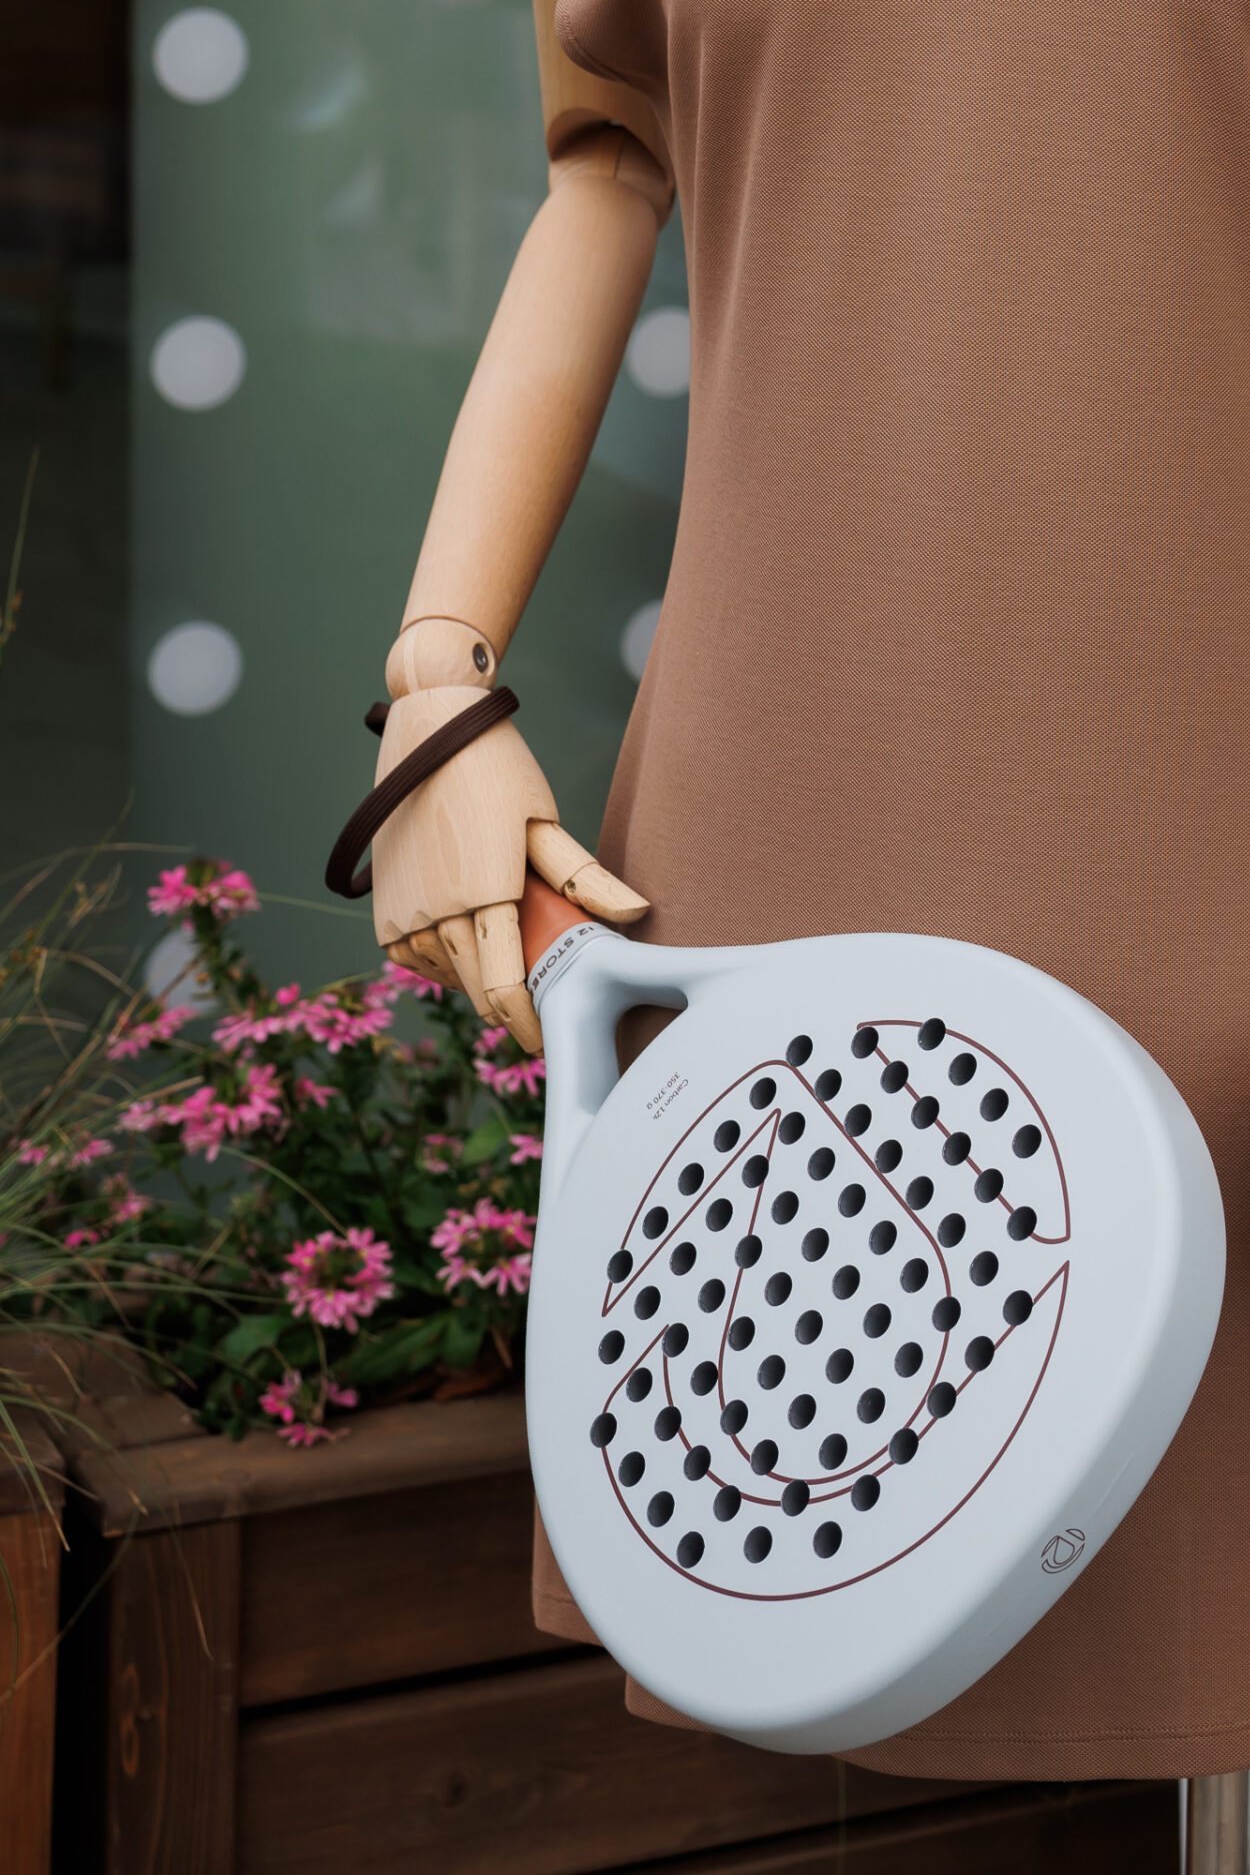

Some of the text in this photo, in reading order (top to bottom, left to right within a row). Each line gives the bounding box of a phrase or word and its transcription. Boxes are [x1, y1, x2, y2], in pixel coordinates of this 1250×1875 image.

[530, 926, 595, 994] 12 STORE
[664, 1078, 689, 1106] Carbon
